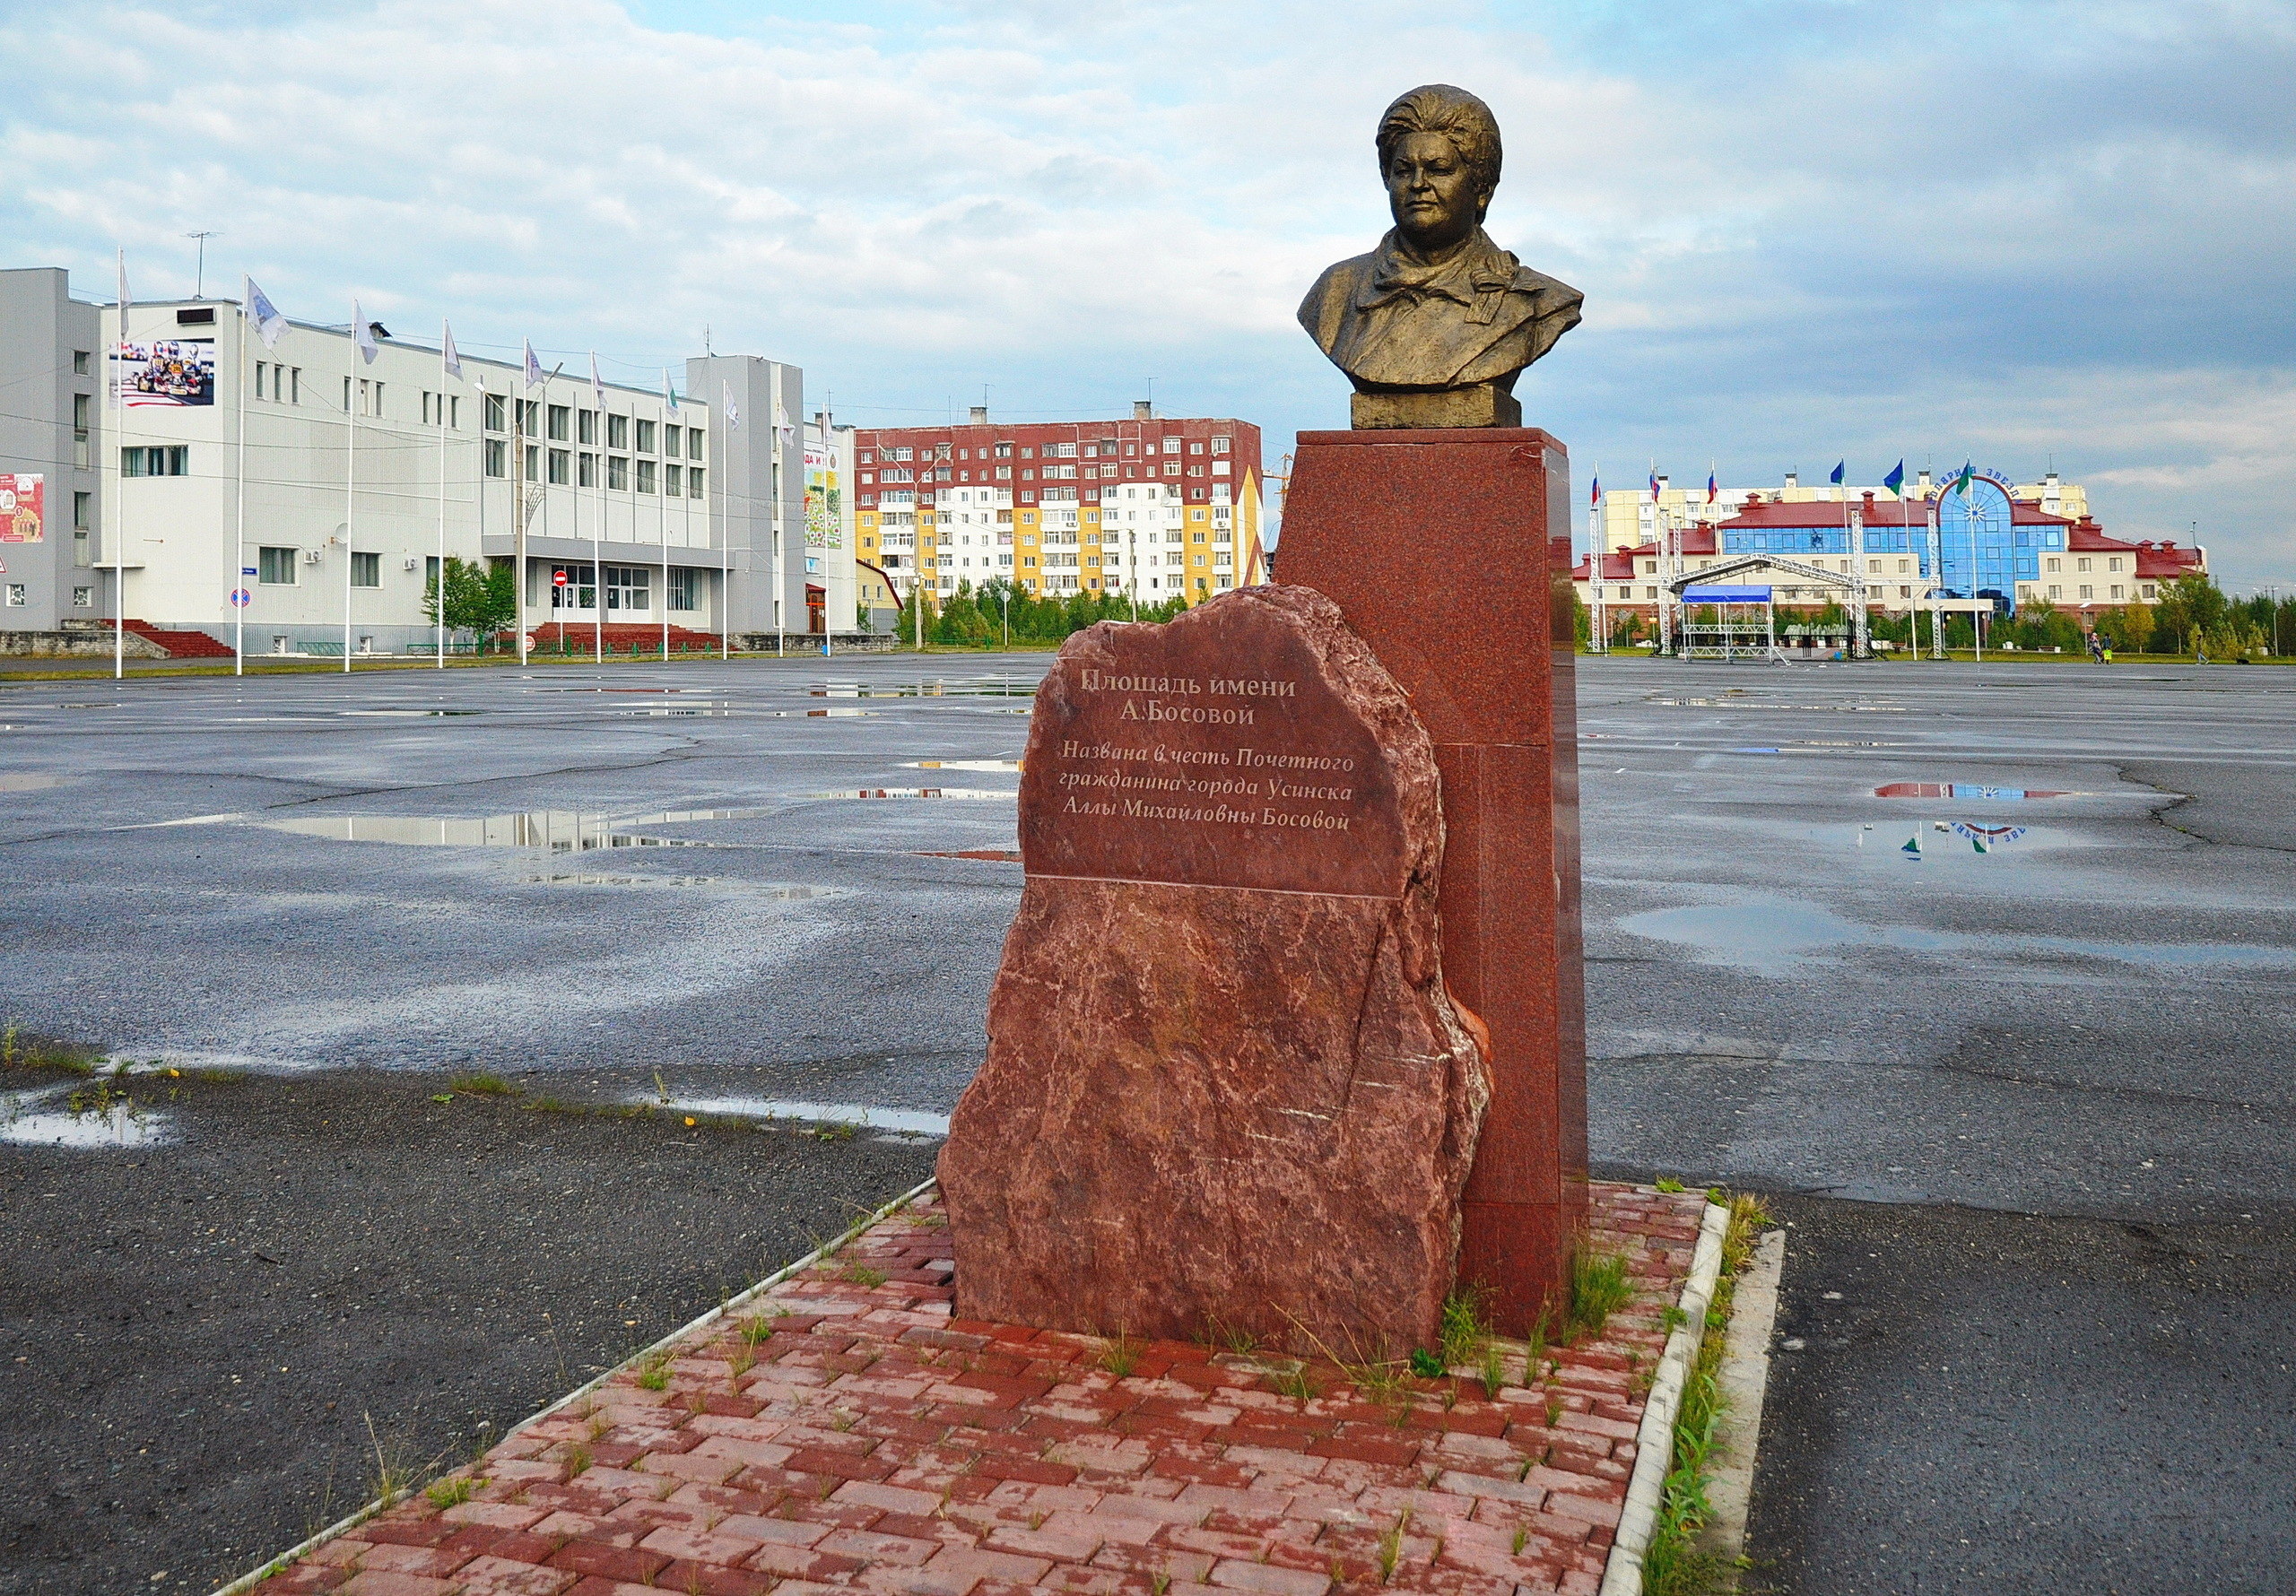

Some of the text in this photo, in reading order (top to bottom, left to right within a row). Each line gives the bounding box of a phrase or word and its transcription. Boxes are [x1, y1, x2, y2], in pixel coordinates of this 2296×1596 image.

[1926, 465, 1977, 505] ОЛЯРНЯ
[1080, 668, 1297, 698] Площадь имени
[1119, 698, 1256, 726] А.Босовой
[1061, 740, 1354, 772] Названа в честь Почетного
[1057, 768, 1352, 801] гражданина города Усинска
[1062, 795, 1350, 831] Аллы Михайловны Босовой
